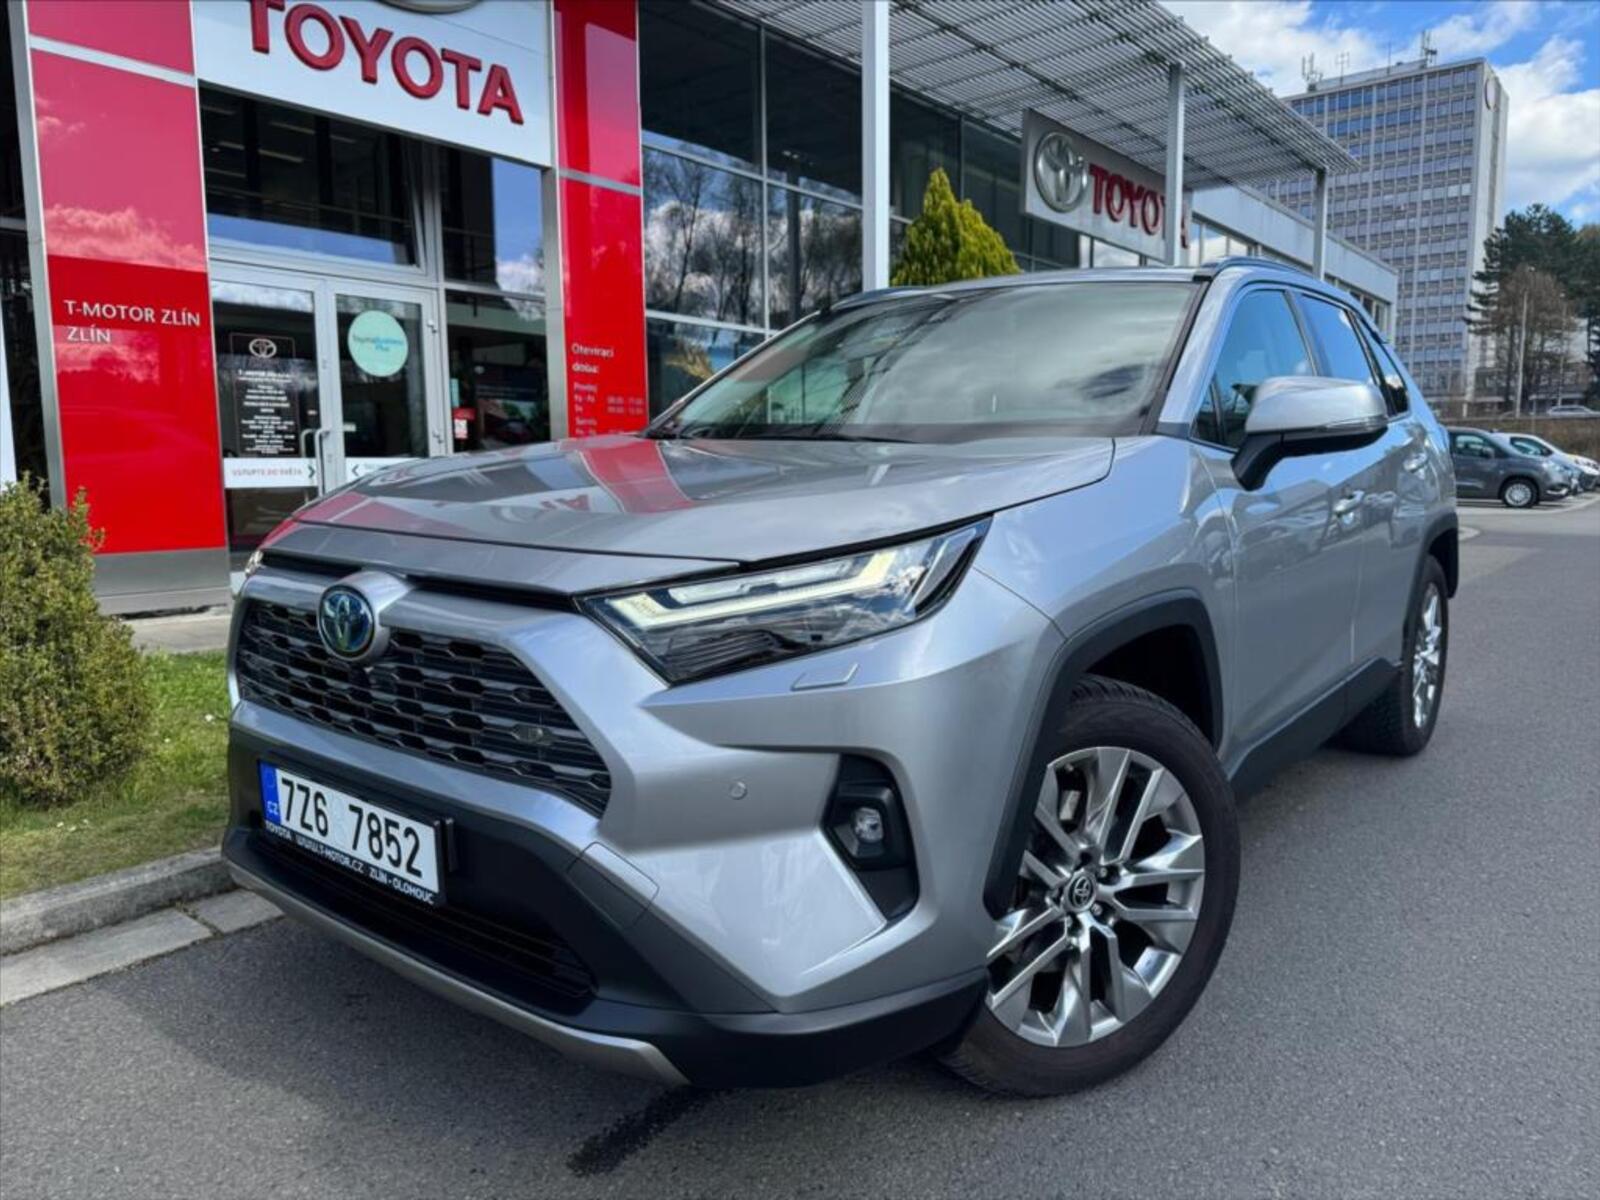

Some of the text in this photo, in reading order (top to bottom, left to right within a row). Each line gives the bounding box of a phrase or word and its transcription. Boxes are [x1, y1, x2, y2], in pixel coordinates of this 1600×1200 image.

[246, 0, 524, 125] TOYOTA
[1088, 162, 1189, 249] TOYO
[64, 299, 201, 327] T-MOTOR ZLÍN
[66, 324, 112, 343] ZLÍN
[267, 800, 279, 816] CZ
[281, 777, 422, 879] 7Z6 7852
